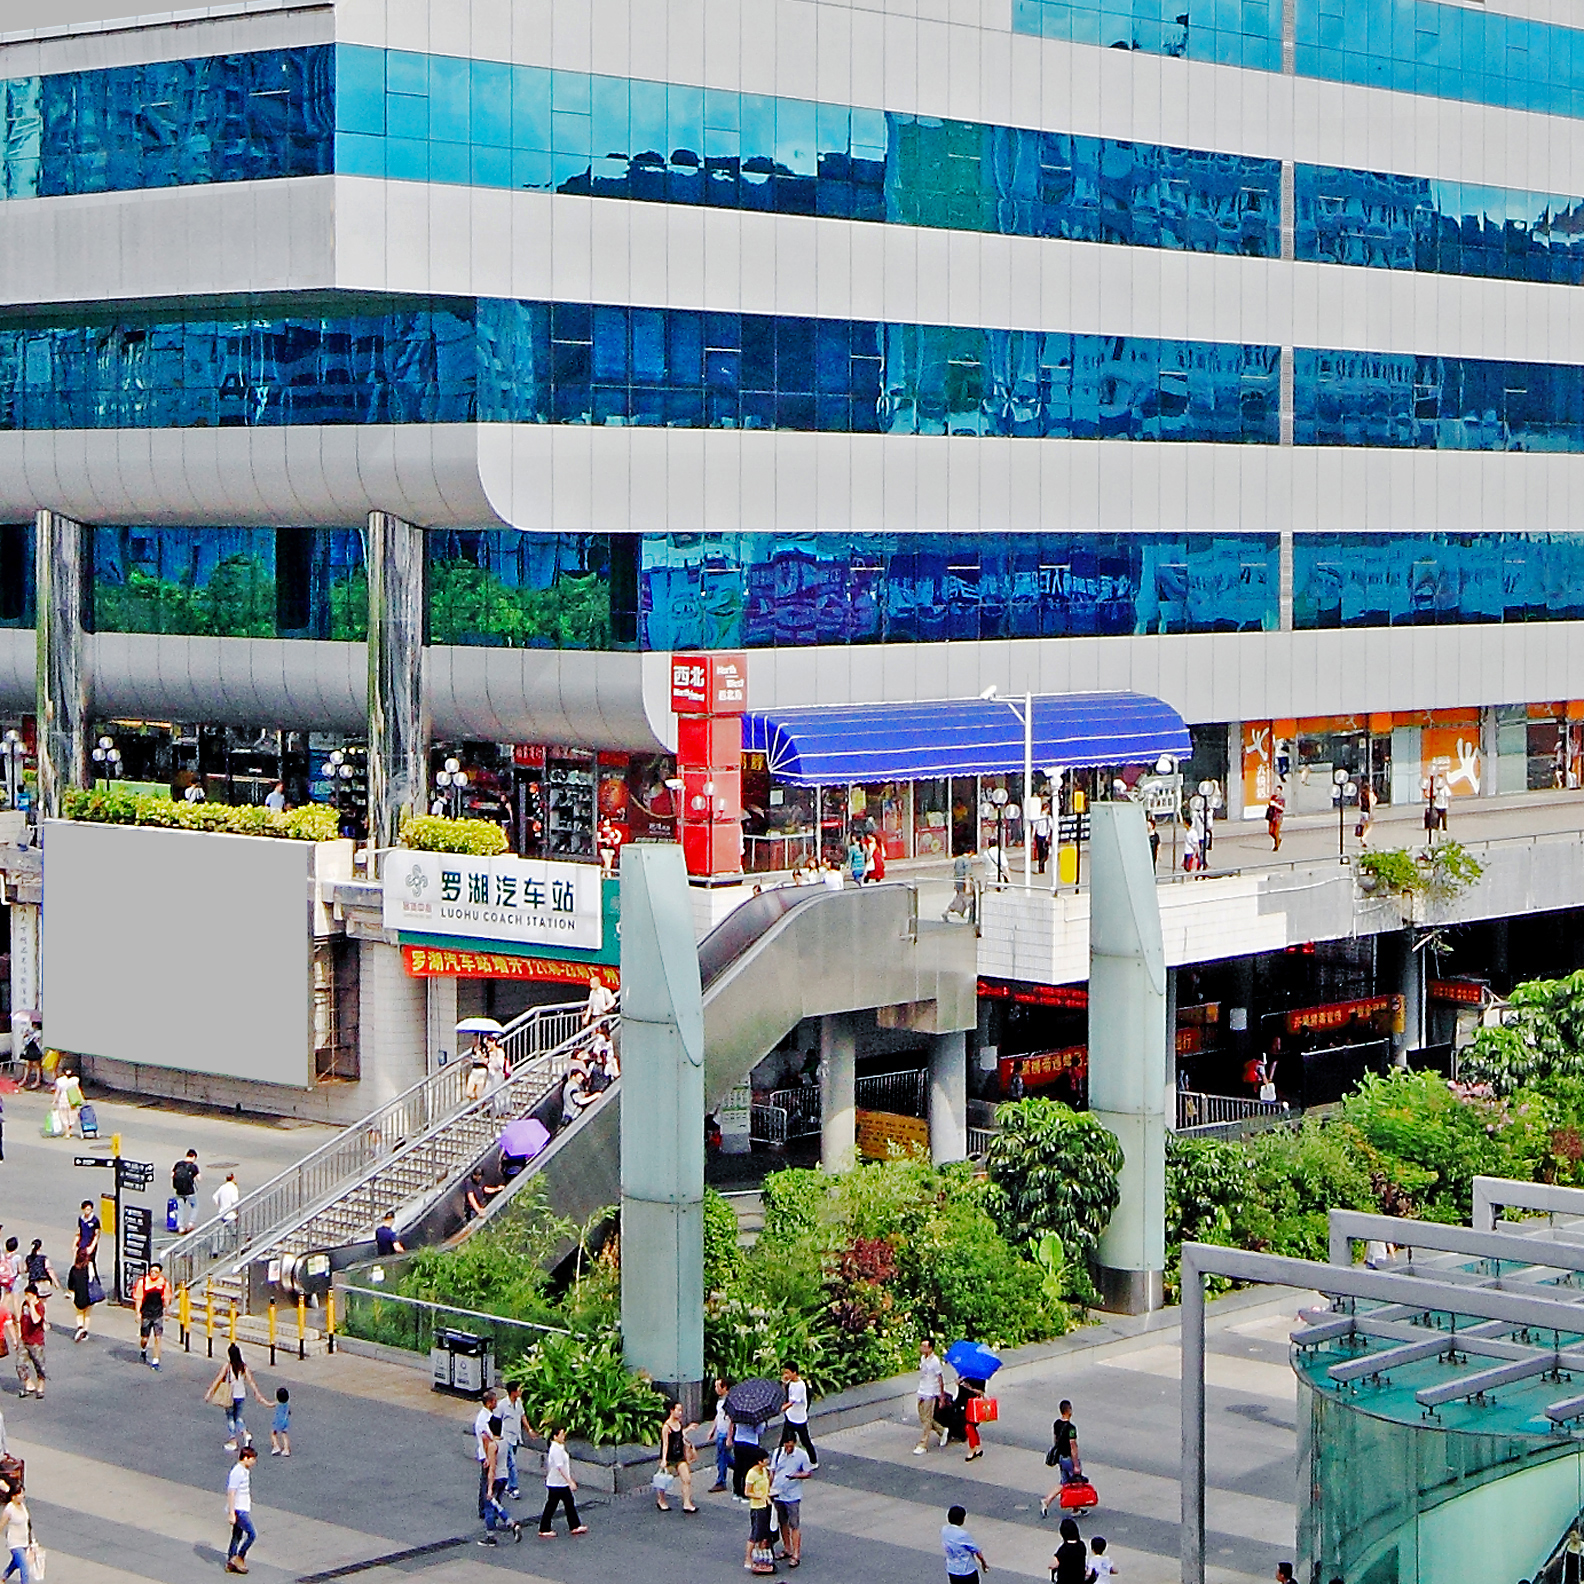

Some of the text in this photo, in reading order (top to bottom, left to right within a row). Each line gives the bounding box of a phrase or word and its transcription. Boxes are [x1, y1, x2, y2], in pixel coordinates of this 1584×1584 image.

[673, 665, 705, 687] 西北
[441, 870, 574, 913] 罗湖汽车站
[441, 907, 479, 922] LUOHU
[483, 911, 522, 925] COACH
[527, 916, 575, 930] STATION
